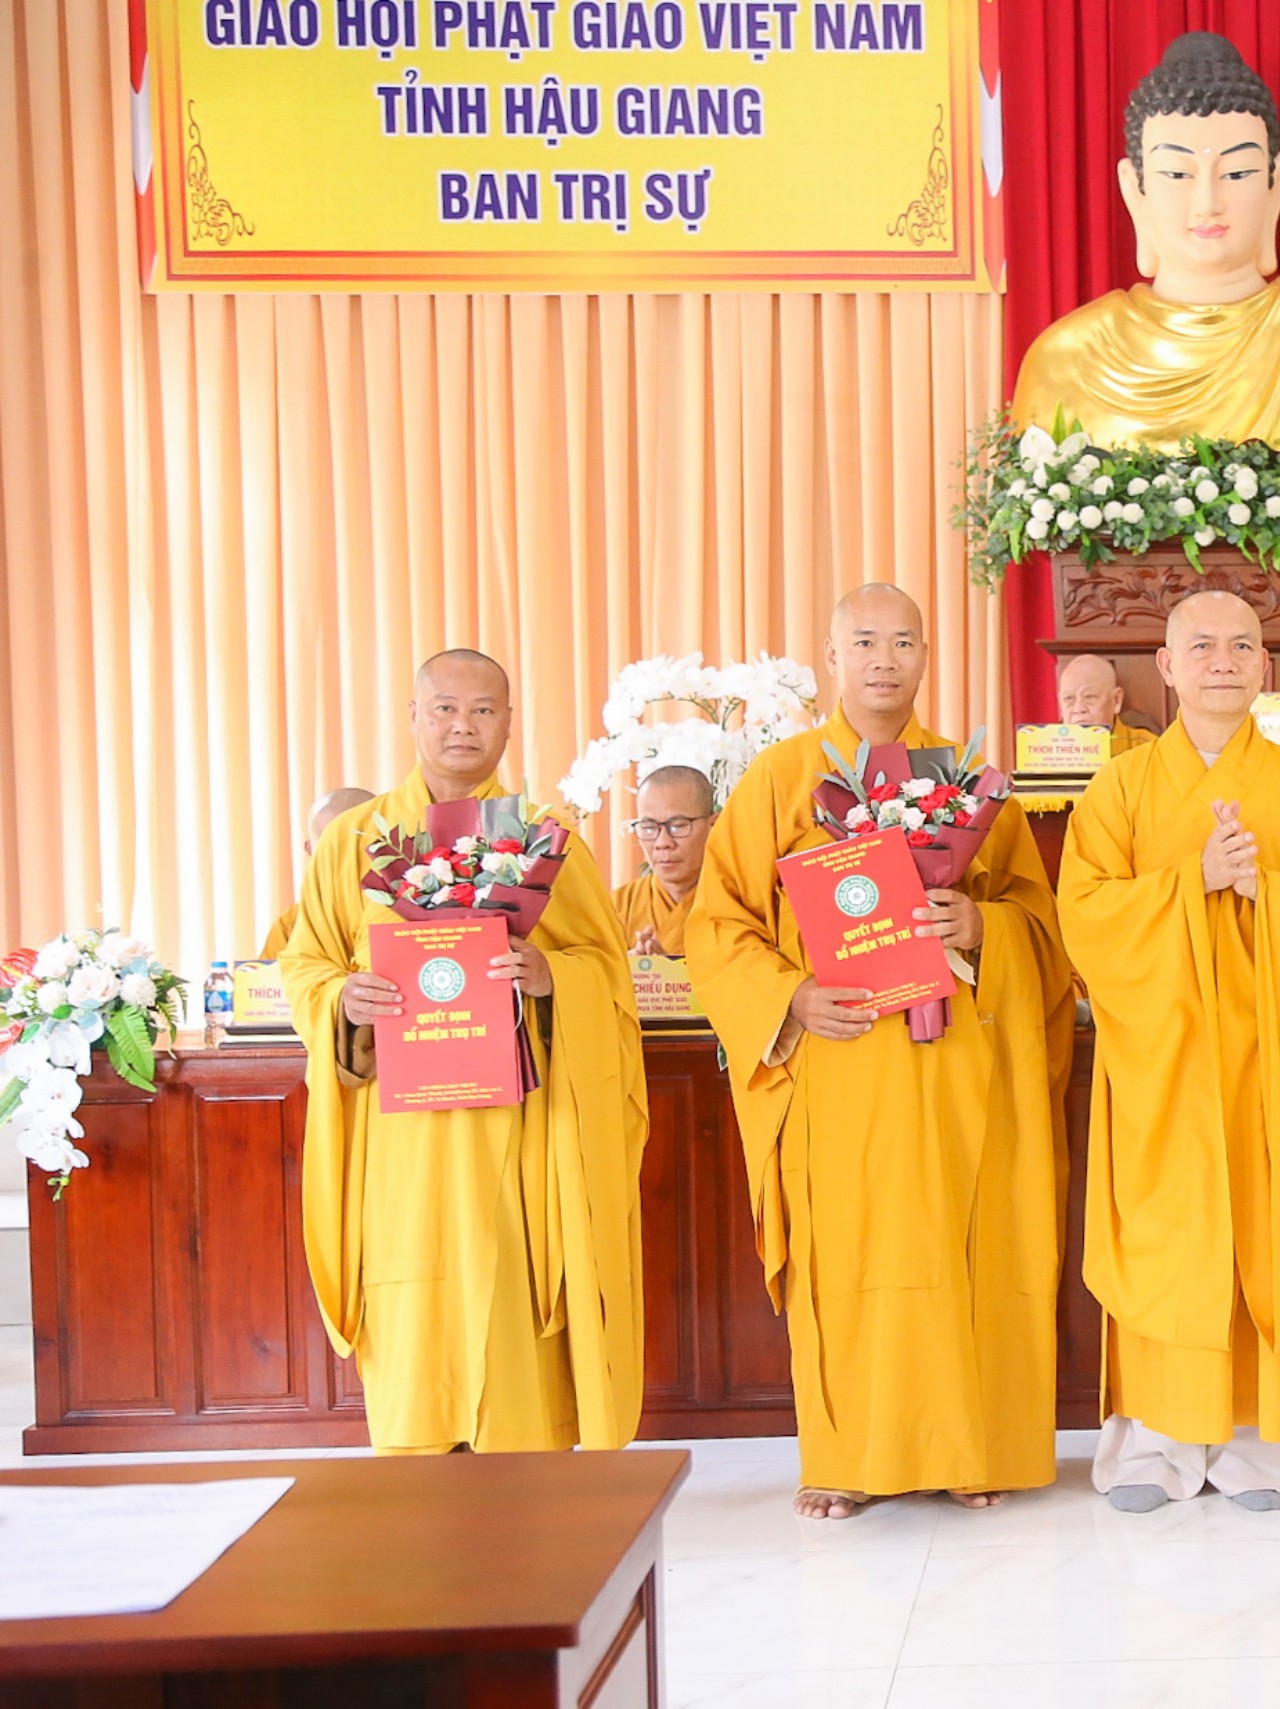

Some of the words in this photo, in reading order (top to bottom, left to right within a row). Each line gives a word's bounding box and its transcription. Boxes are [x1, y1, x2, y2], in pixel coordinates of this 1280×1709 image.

[814, 3, 923, 50] NAM
[377, 69, 487, 135] TỈNH
[504, 77, 598, 146] HẬU
[616, 87, 762, 136] GIANG
[440, 173, 539, 220] BAN
[554, 173, 627, 232] TRỊ
[645, 168, 712, 232] SỰ
